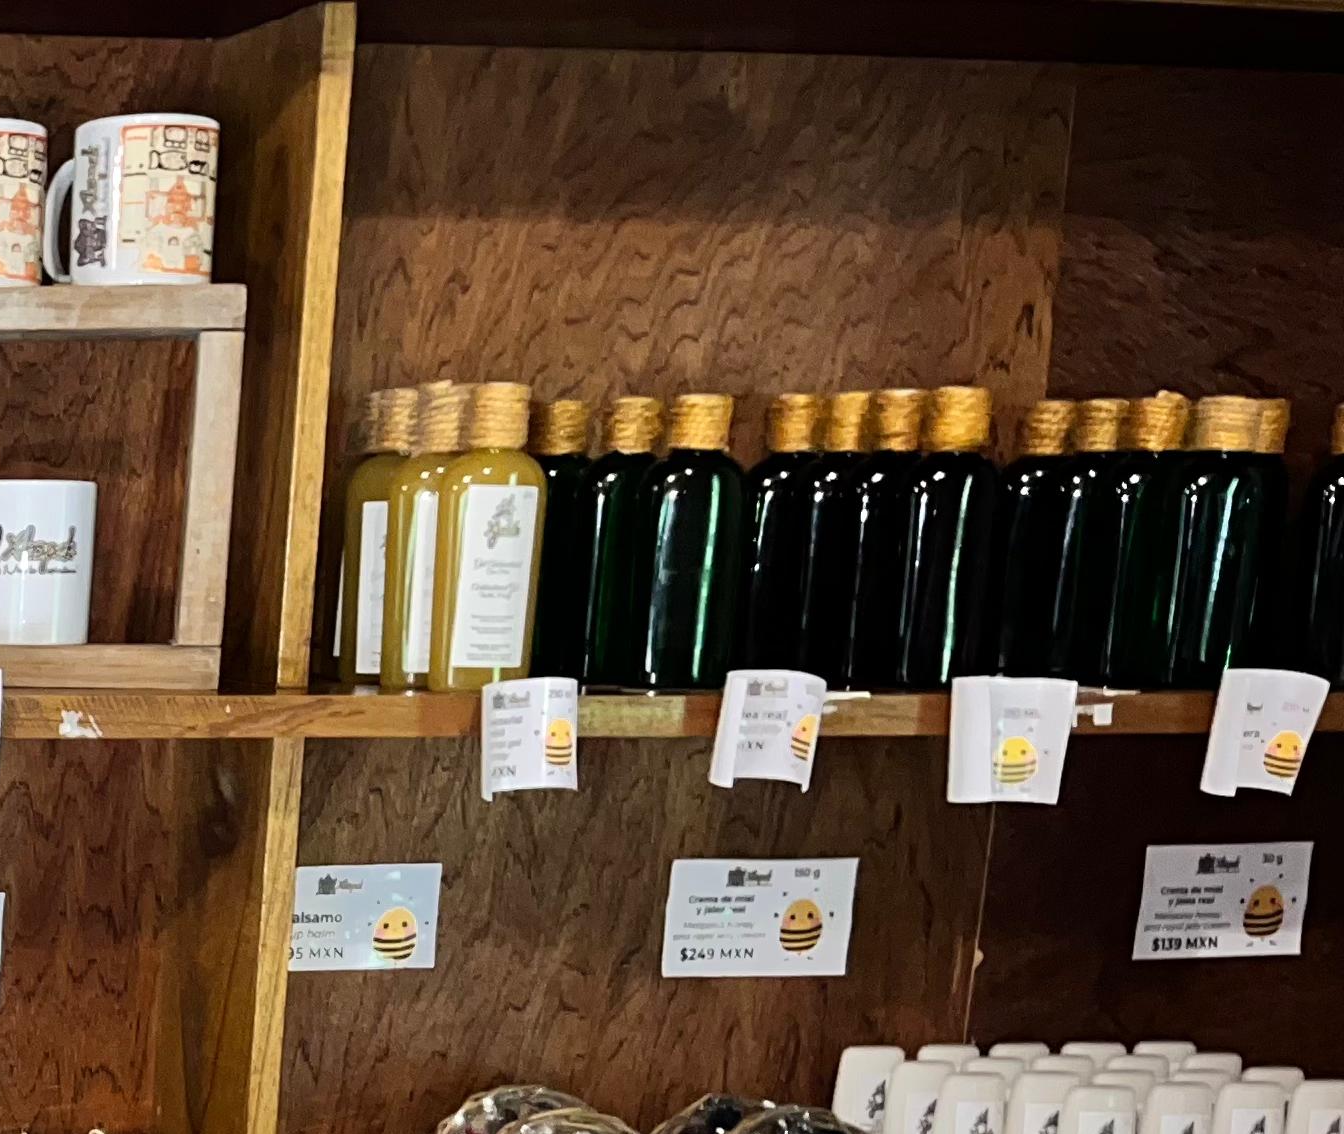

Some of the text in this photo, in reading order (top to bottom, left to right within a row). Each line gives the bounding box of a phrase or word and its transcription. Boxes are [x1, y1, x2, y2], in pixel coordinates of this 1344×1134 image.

[688, 894, 756, 904] Crema de miel
[292, 911, 343, 923] alsamo
[1151, 936, 1219, 952] $139 MXN
[308, 947, 344, 960] MXN
[680, 947, 755, 962] $249 MXN
